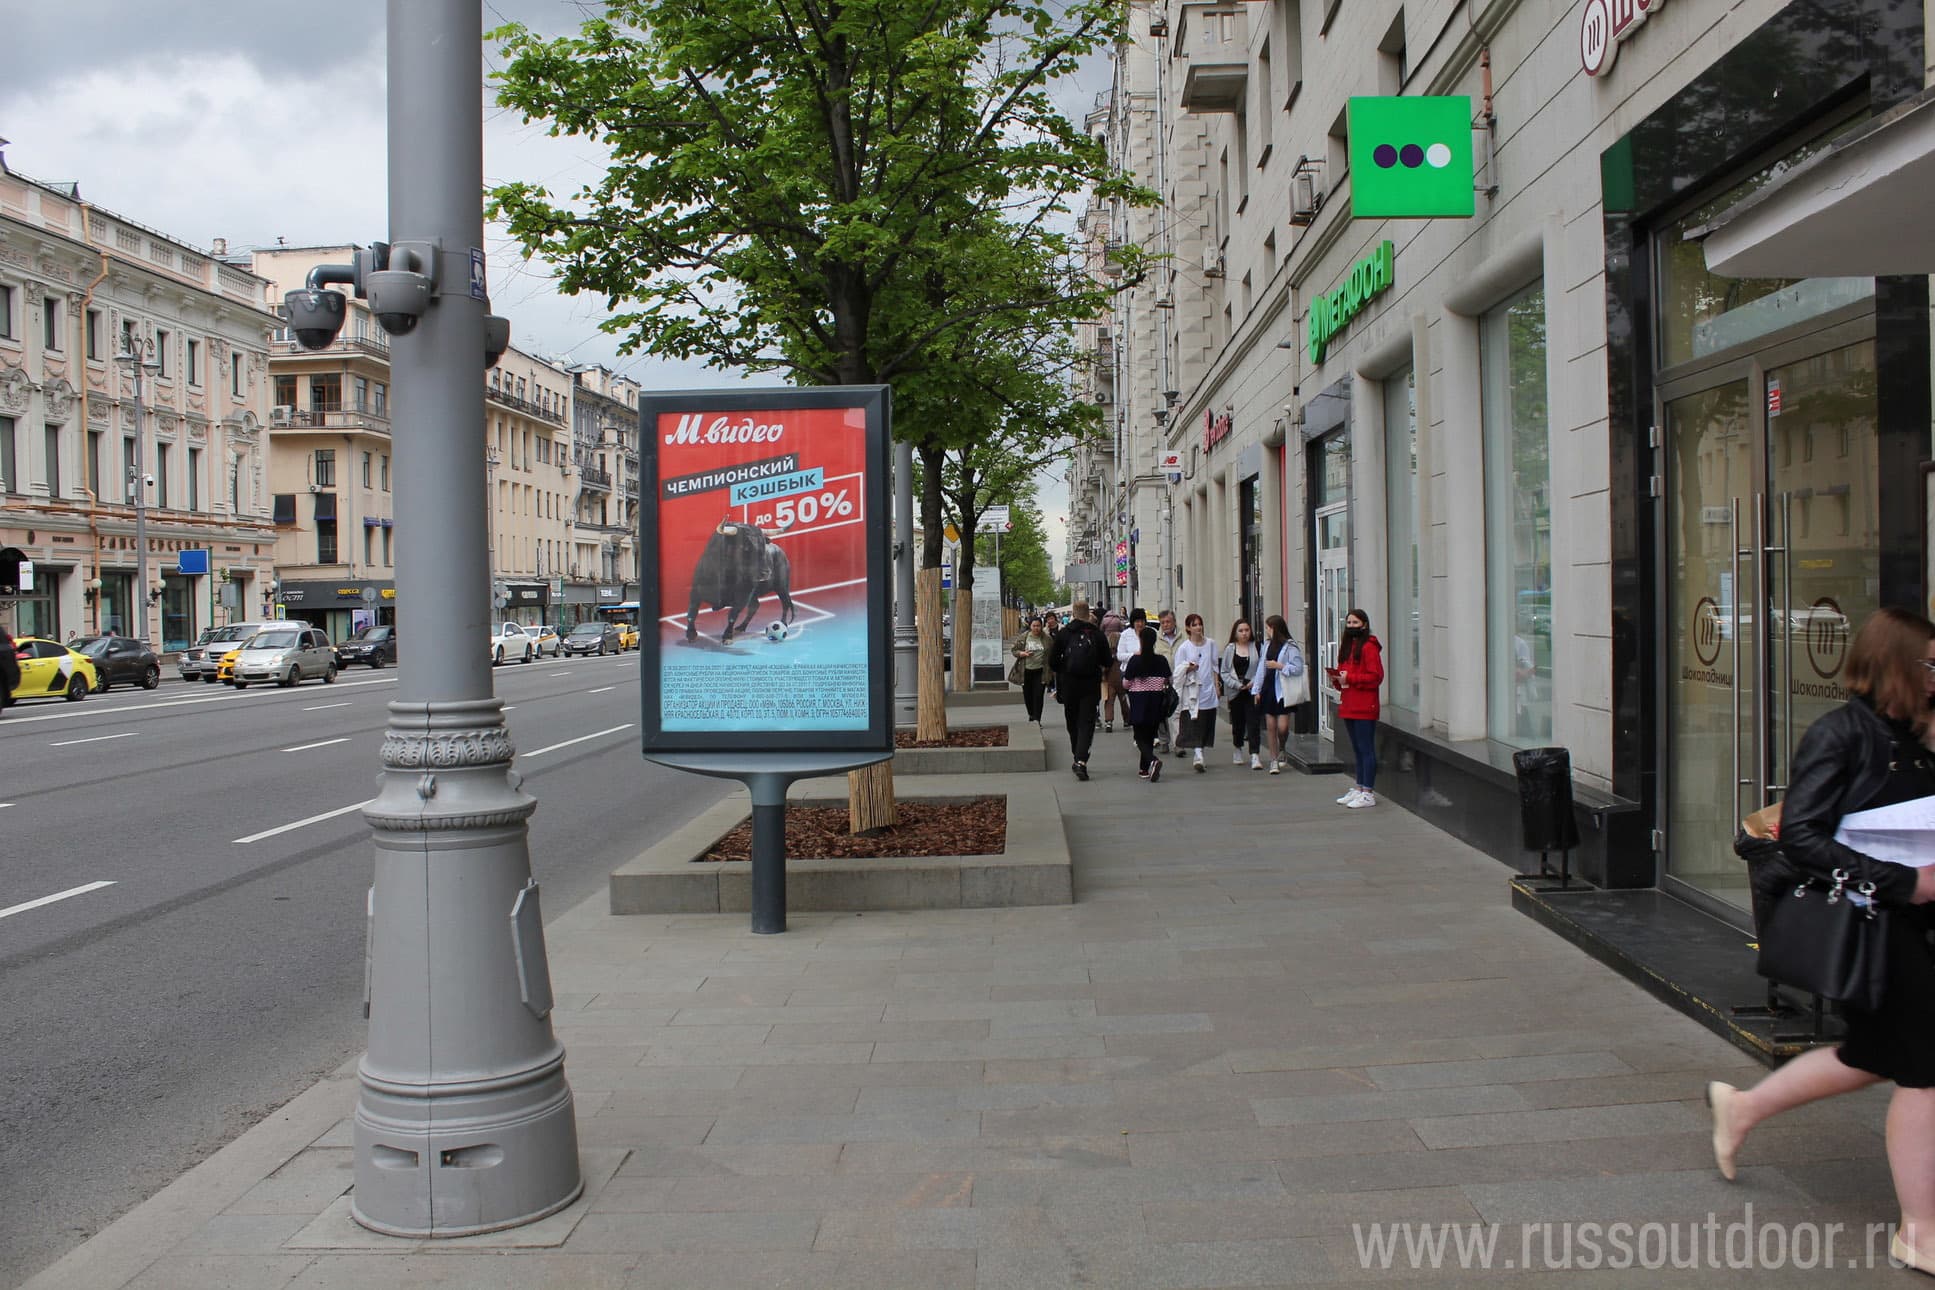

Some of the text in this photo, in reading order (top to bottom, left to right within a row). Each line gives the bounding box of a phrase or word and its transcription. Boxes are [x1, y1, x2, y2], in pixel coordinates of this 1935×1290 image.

[1321, 240, 1393, 343] МЕГАФОН
[664, 413, 784, 445] М.видео
[667, 456, 794, 495] ЧЕМПИОНСКИЙ
[737, 473, 816, 501] КЭШБЫК
[754, 489, 853, 529] до 50%
